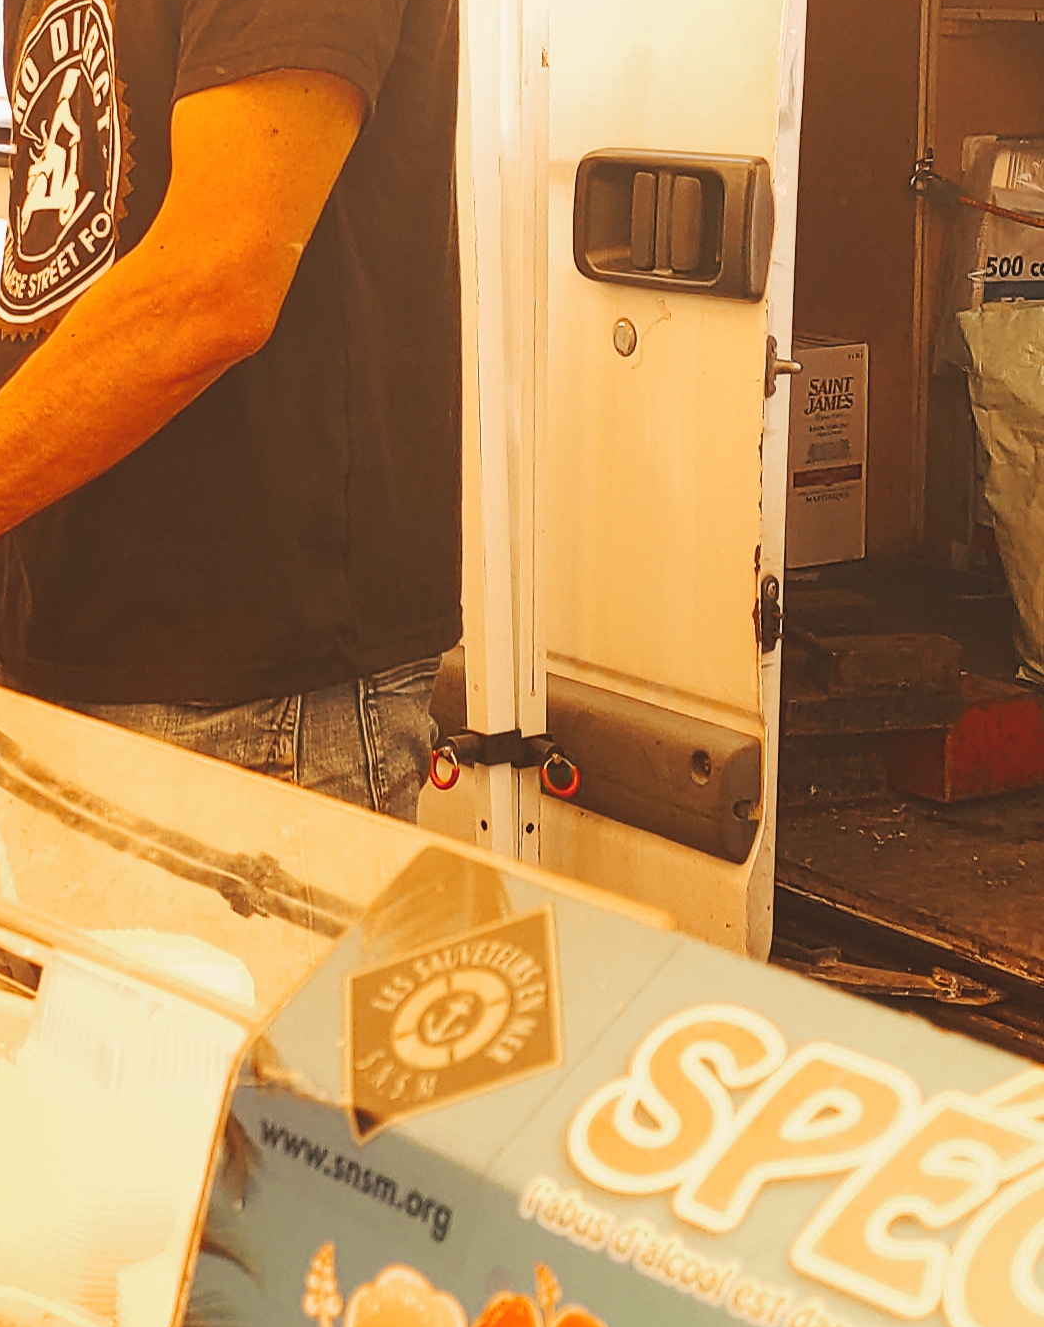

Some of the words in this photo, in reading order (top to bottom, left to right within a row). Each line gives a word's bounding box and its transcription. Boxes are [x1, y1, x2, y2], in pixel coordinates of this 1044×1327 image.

[28, 241, 80, 298] STREET
[985, 255, 1023, 278] 500
[804, 393, 854, 415] JAMES
[808, 377, 854, 396] SAINT
[371, 974, 416, 1013] LES
[413, 939, 545, 990] SAUVETEURS
[261, 1119, 452, 1243] www.snsm.org
[524, 1182, 605, 1245] l'abus
[613, 1224, 734, 1300] d'alcool
[733, 1282, 786, 1325] est
